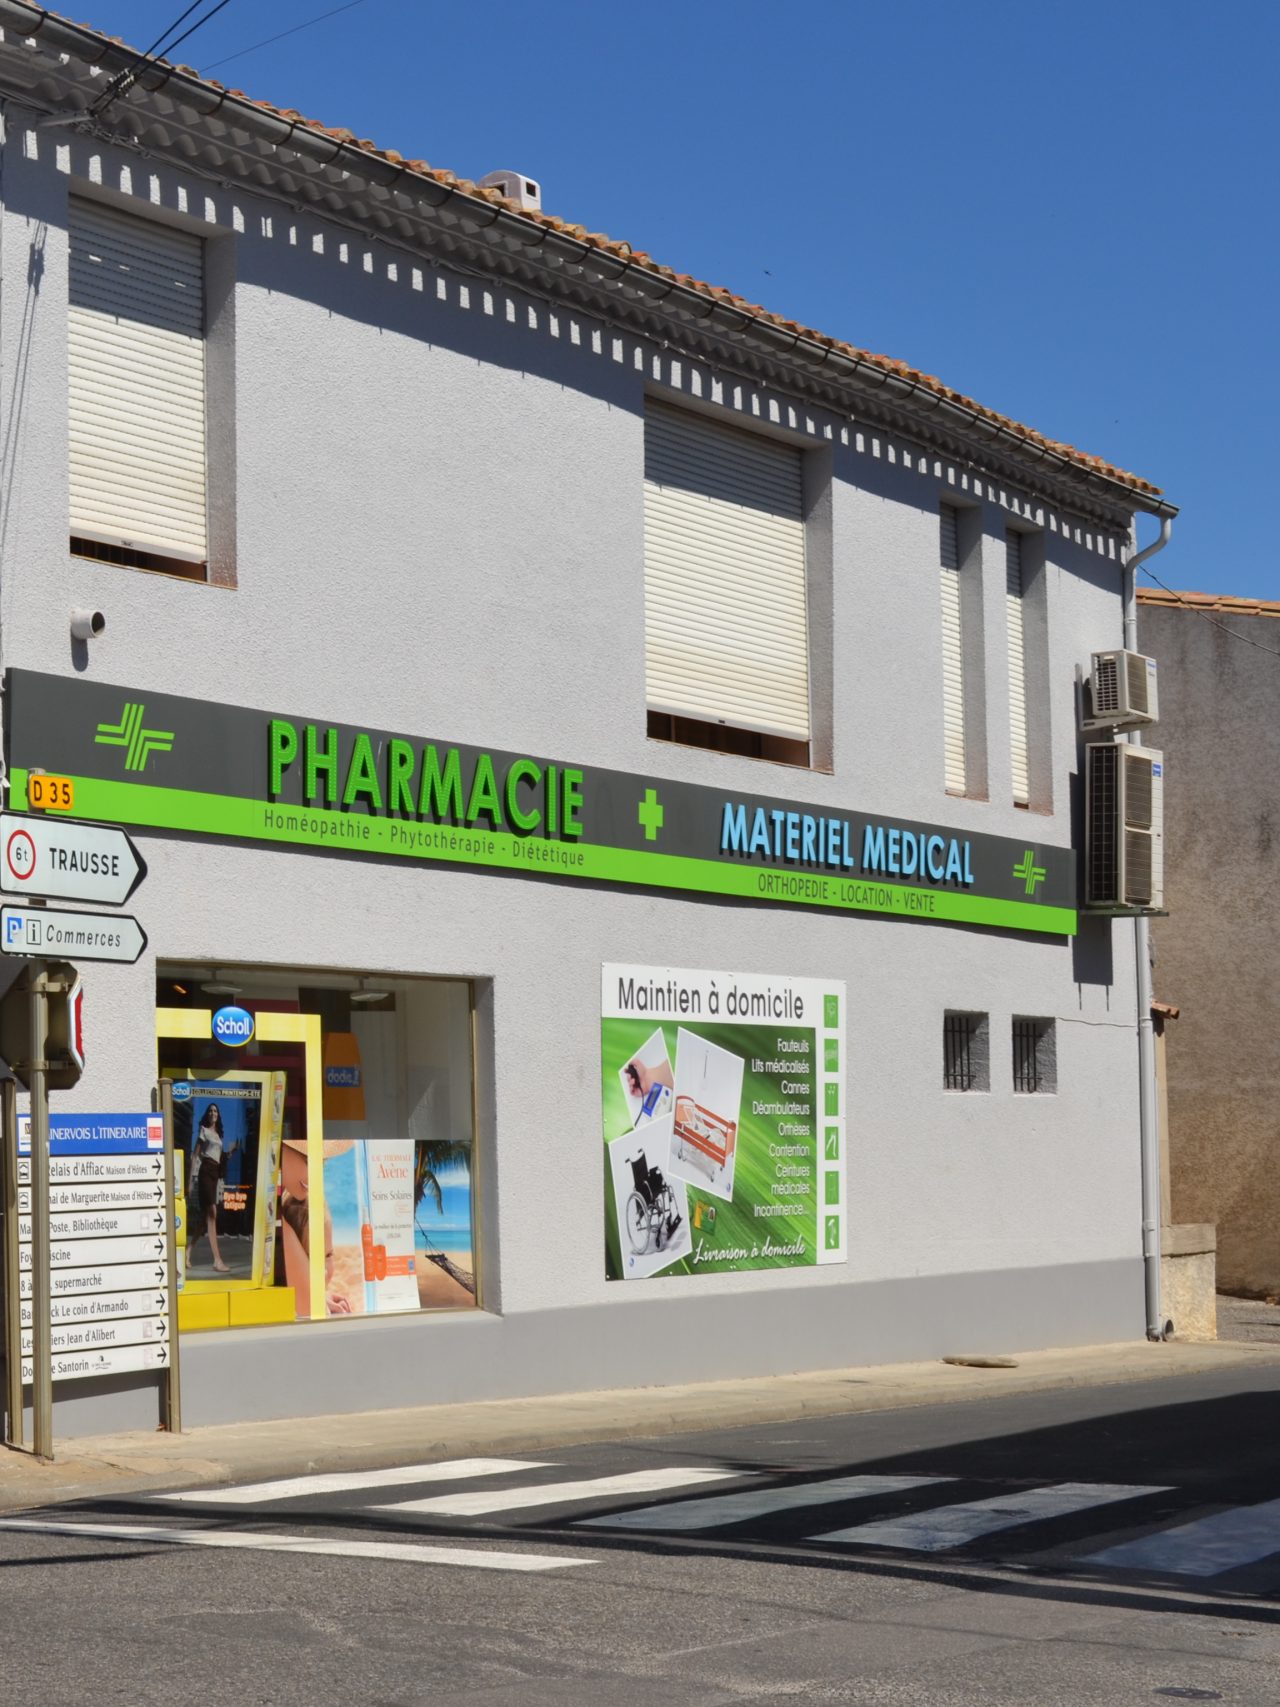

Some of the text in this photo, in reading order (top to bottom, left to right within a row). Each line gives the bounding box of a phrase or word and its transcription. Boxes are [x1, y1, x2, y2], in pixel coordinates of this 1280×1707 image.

[268, 719, 585, 837] PHARMACIE
[33, 780, 71, 805] D 35
[263, 808, 371, 840] Homéopathie
[389, 825, 495, 856] Phytothérapie
[512, 839, 585, 868] Diététique
[720, 802, 975, 884] MATERIEL MEDICAL
[48, 847, 120, 877] TRAUSSE
[757, 872, 829, 900] ORTHOPEDIE
[840, 884, 893, 907] LOCATION
[903, 892, 936, 913] VENTE
[46, 924, 121, 948] Commerces
[618, 976, 804, 1019] Maintien à domicile
[216, 1015, 250, 1036] Scholl
[777, 1038, 810, 1053] Fauteuils
[751, 1058, 810, 1075] Lits médicalisés
[780, 1080, 810, 1095] Cannes
[752, 1100, 810, 1116] Déambulateurs
[49, 1127, 91, 1141] INERVOIS
[770, 1142, 810, 1157] Contention
[775, 1163, 810, 1178] Ceintures
[60, 1191, 69, 1205] de
[70, 1191, 110, 1206] Marguerite
[72, 1218, 118, 1233] Bibliothèque
[692, 1237, 748, 1265] Livraison
[761, 1233, 806, 1258] domicile
[54, 1273, 102, 1291] supermarché
[61, 1305, 71, 1317] Le
[72, 1303, 88, 1316] coin
[89, 1299, 129, 1315] d'Armando
[66, 1332, 83, 1346] Jean
[84, 1328, 116, 1342] d'Alibert
[57, 1359, 90, 1374] Santorin
